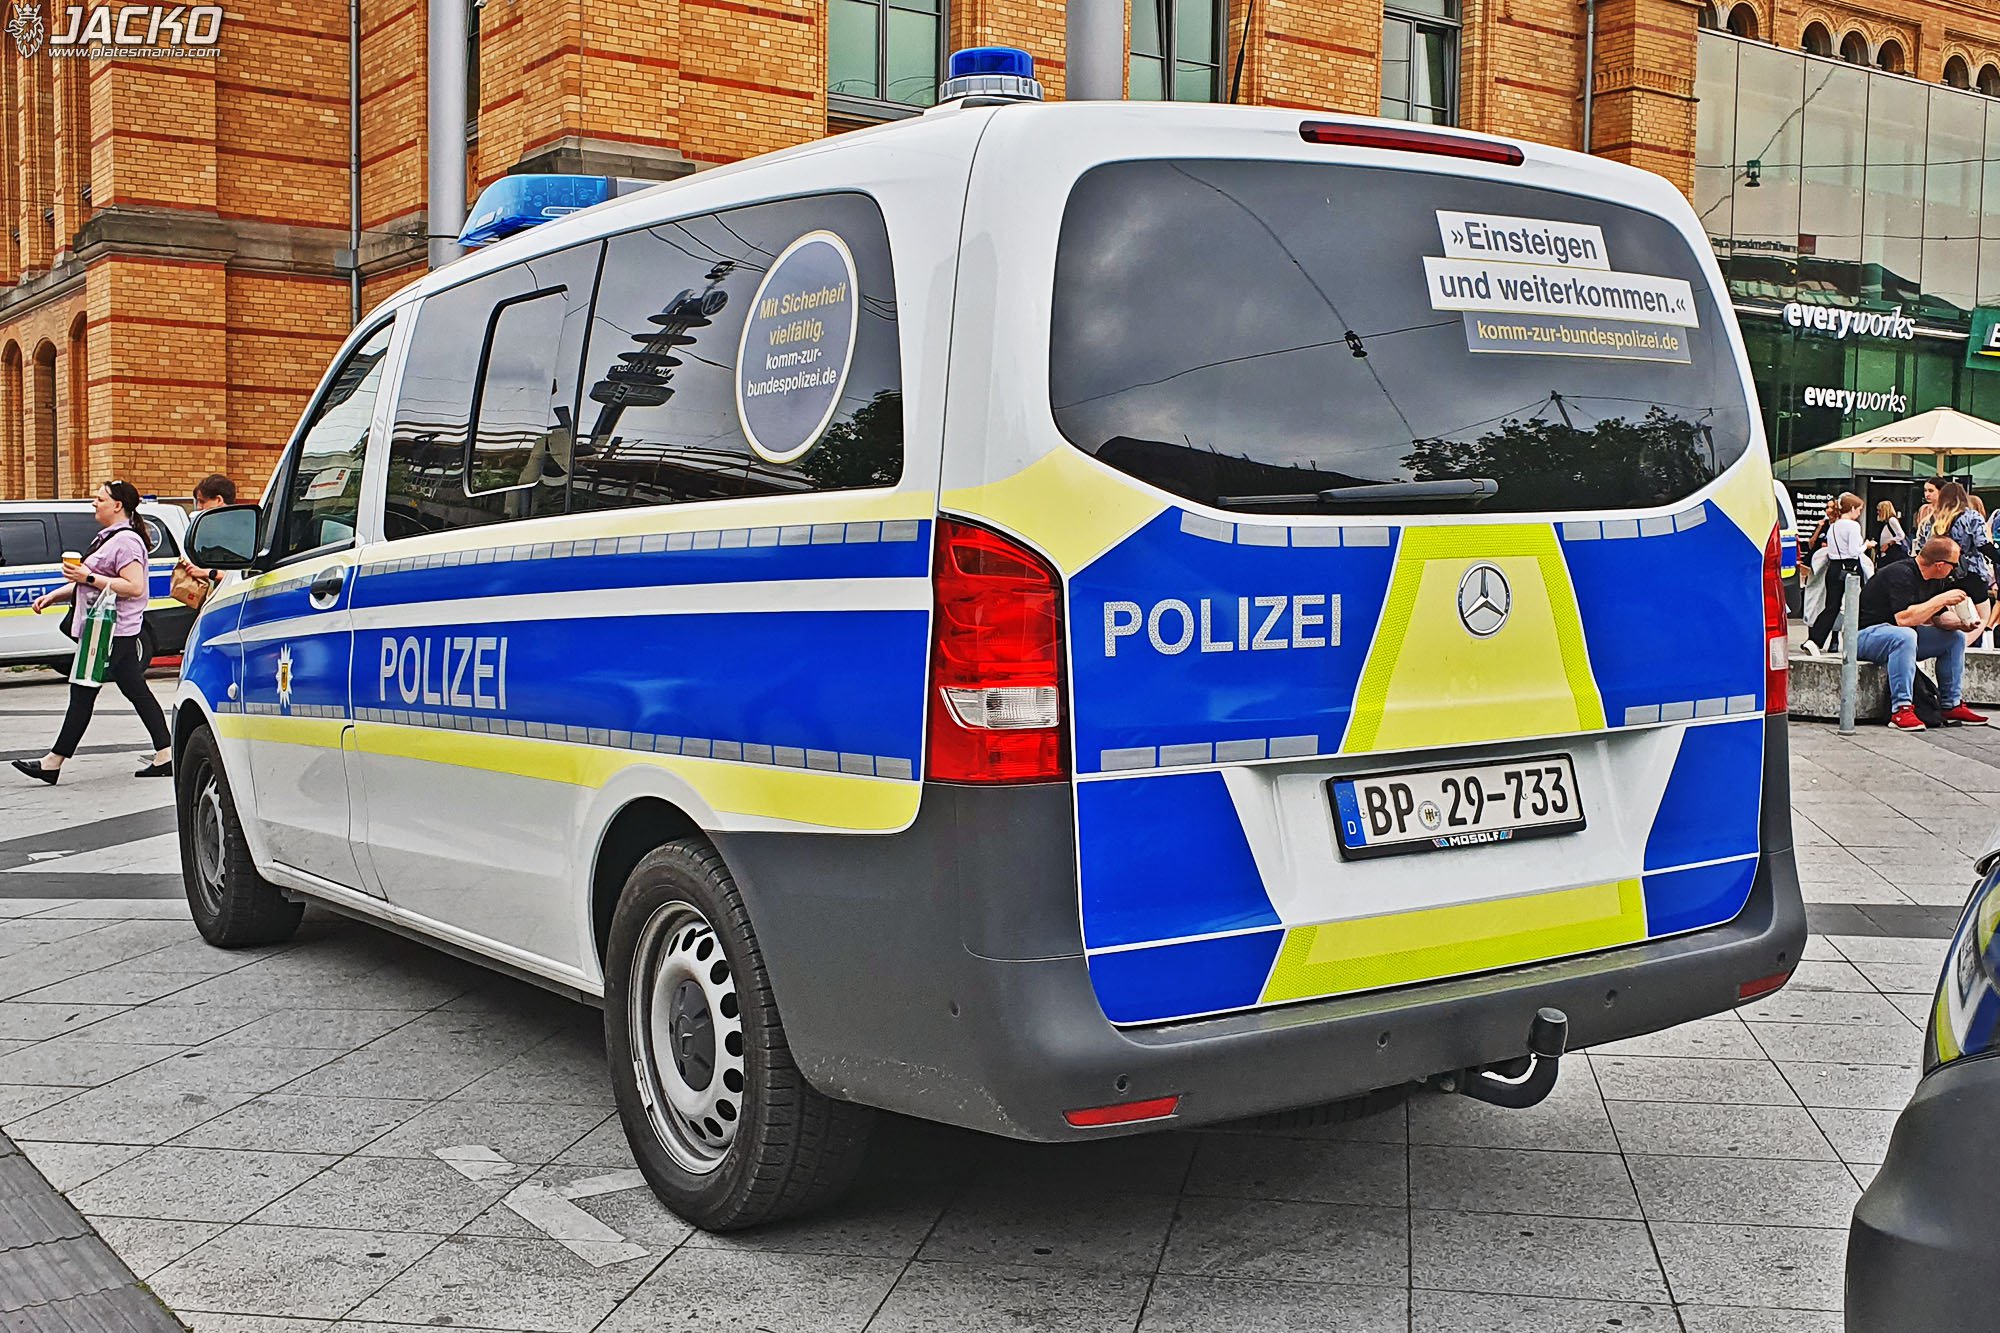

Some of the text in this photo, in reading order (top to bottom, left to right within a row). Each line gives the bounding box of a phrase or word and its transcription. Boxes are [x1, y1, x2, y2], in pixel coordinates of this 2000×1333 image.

[1439, 271, 1491, 300] und
[759, 282, 847, 320] Mit Sicherheit
[769, 318, 825, 346] vielfältig.
[1476, 320, 1679, 351] komm-zur-bundespolizei.de
[1785, 302, 1915, 340] everyworks
[765, 347, 822, 371] komm-zur-
[746, 367, 837, 397] bundespolizei.de
[1804, 385, 1907, 415] everyworks
[1103, 594, 1341, 657] POLIZEI
[379, 636, 508, 710] POLIZEI
[1364, 782, 1414, 836] BP
[1441, 767, 1569, 827] 29-733
[1347, 820, 1357, 835] D
[1449, 830, 1500, 847] MOSOLF
